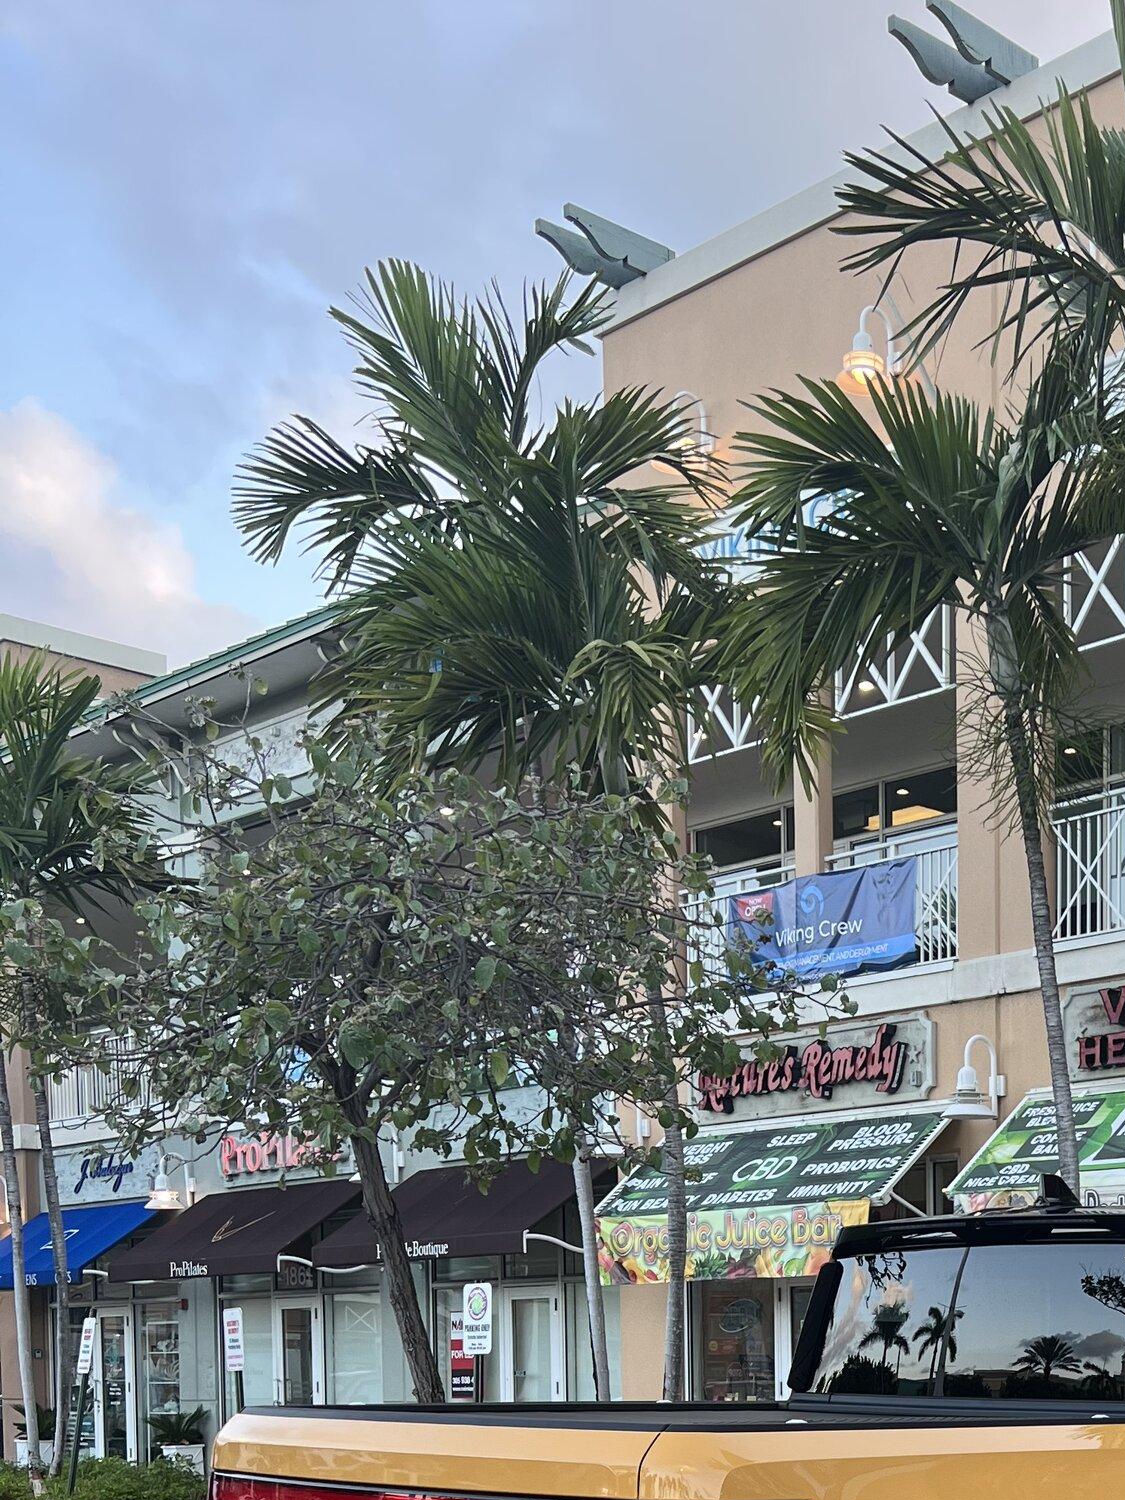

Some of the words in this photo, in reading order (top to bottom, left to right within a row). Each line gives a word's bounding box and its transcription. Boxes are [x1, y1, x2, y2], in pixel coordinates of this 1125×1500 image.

[775, 924, 814, 948] Viking
[819, 918, 863, 938] Crew
[800, 1024, 904, 1099] Remedy
[1022, 1105, 1057, 1118] FRES
[1072, 1101, 1099, 1113] UICE
[854, 1122, 912, 1139] BLOOD
[767, 1133, 817, 1148] SLEEP
[827, 1132, 917, 1151] PRESSURE
[683, 1153, 711, 1166] OSS
[800, 1155, 902, 1176] PROBIOTICS
[732, 1155, 799, 1183] CBD
[999, 1163, 1030, 1175] CBD
[787, 1181, 873, 1198] IMMUNITY
[963, 1176, 999, 1188] NICE
[701, 1188, 778, 1205] DIABETES
[611, 1212, 712, 1265] Orgaic
[714, 1207, 789, 1251] Juice
[792, 1206, 843, 1247] Bar
[413, 1240, 449, 1258] Boutique
[170, 1260, 208, 1277] ProPilates
